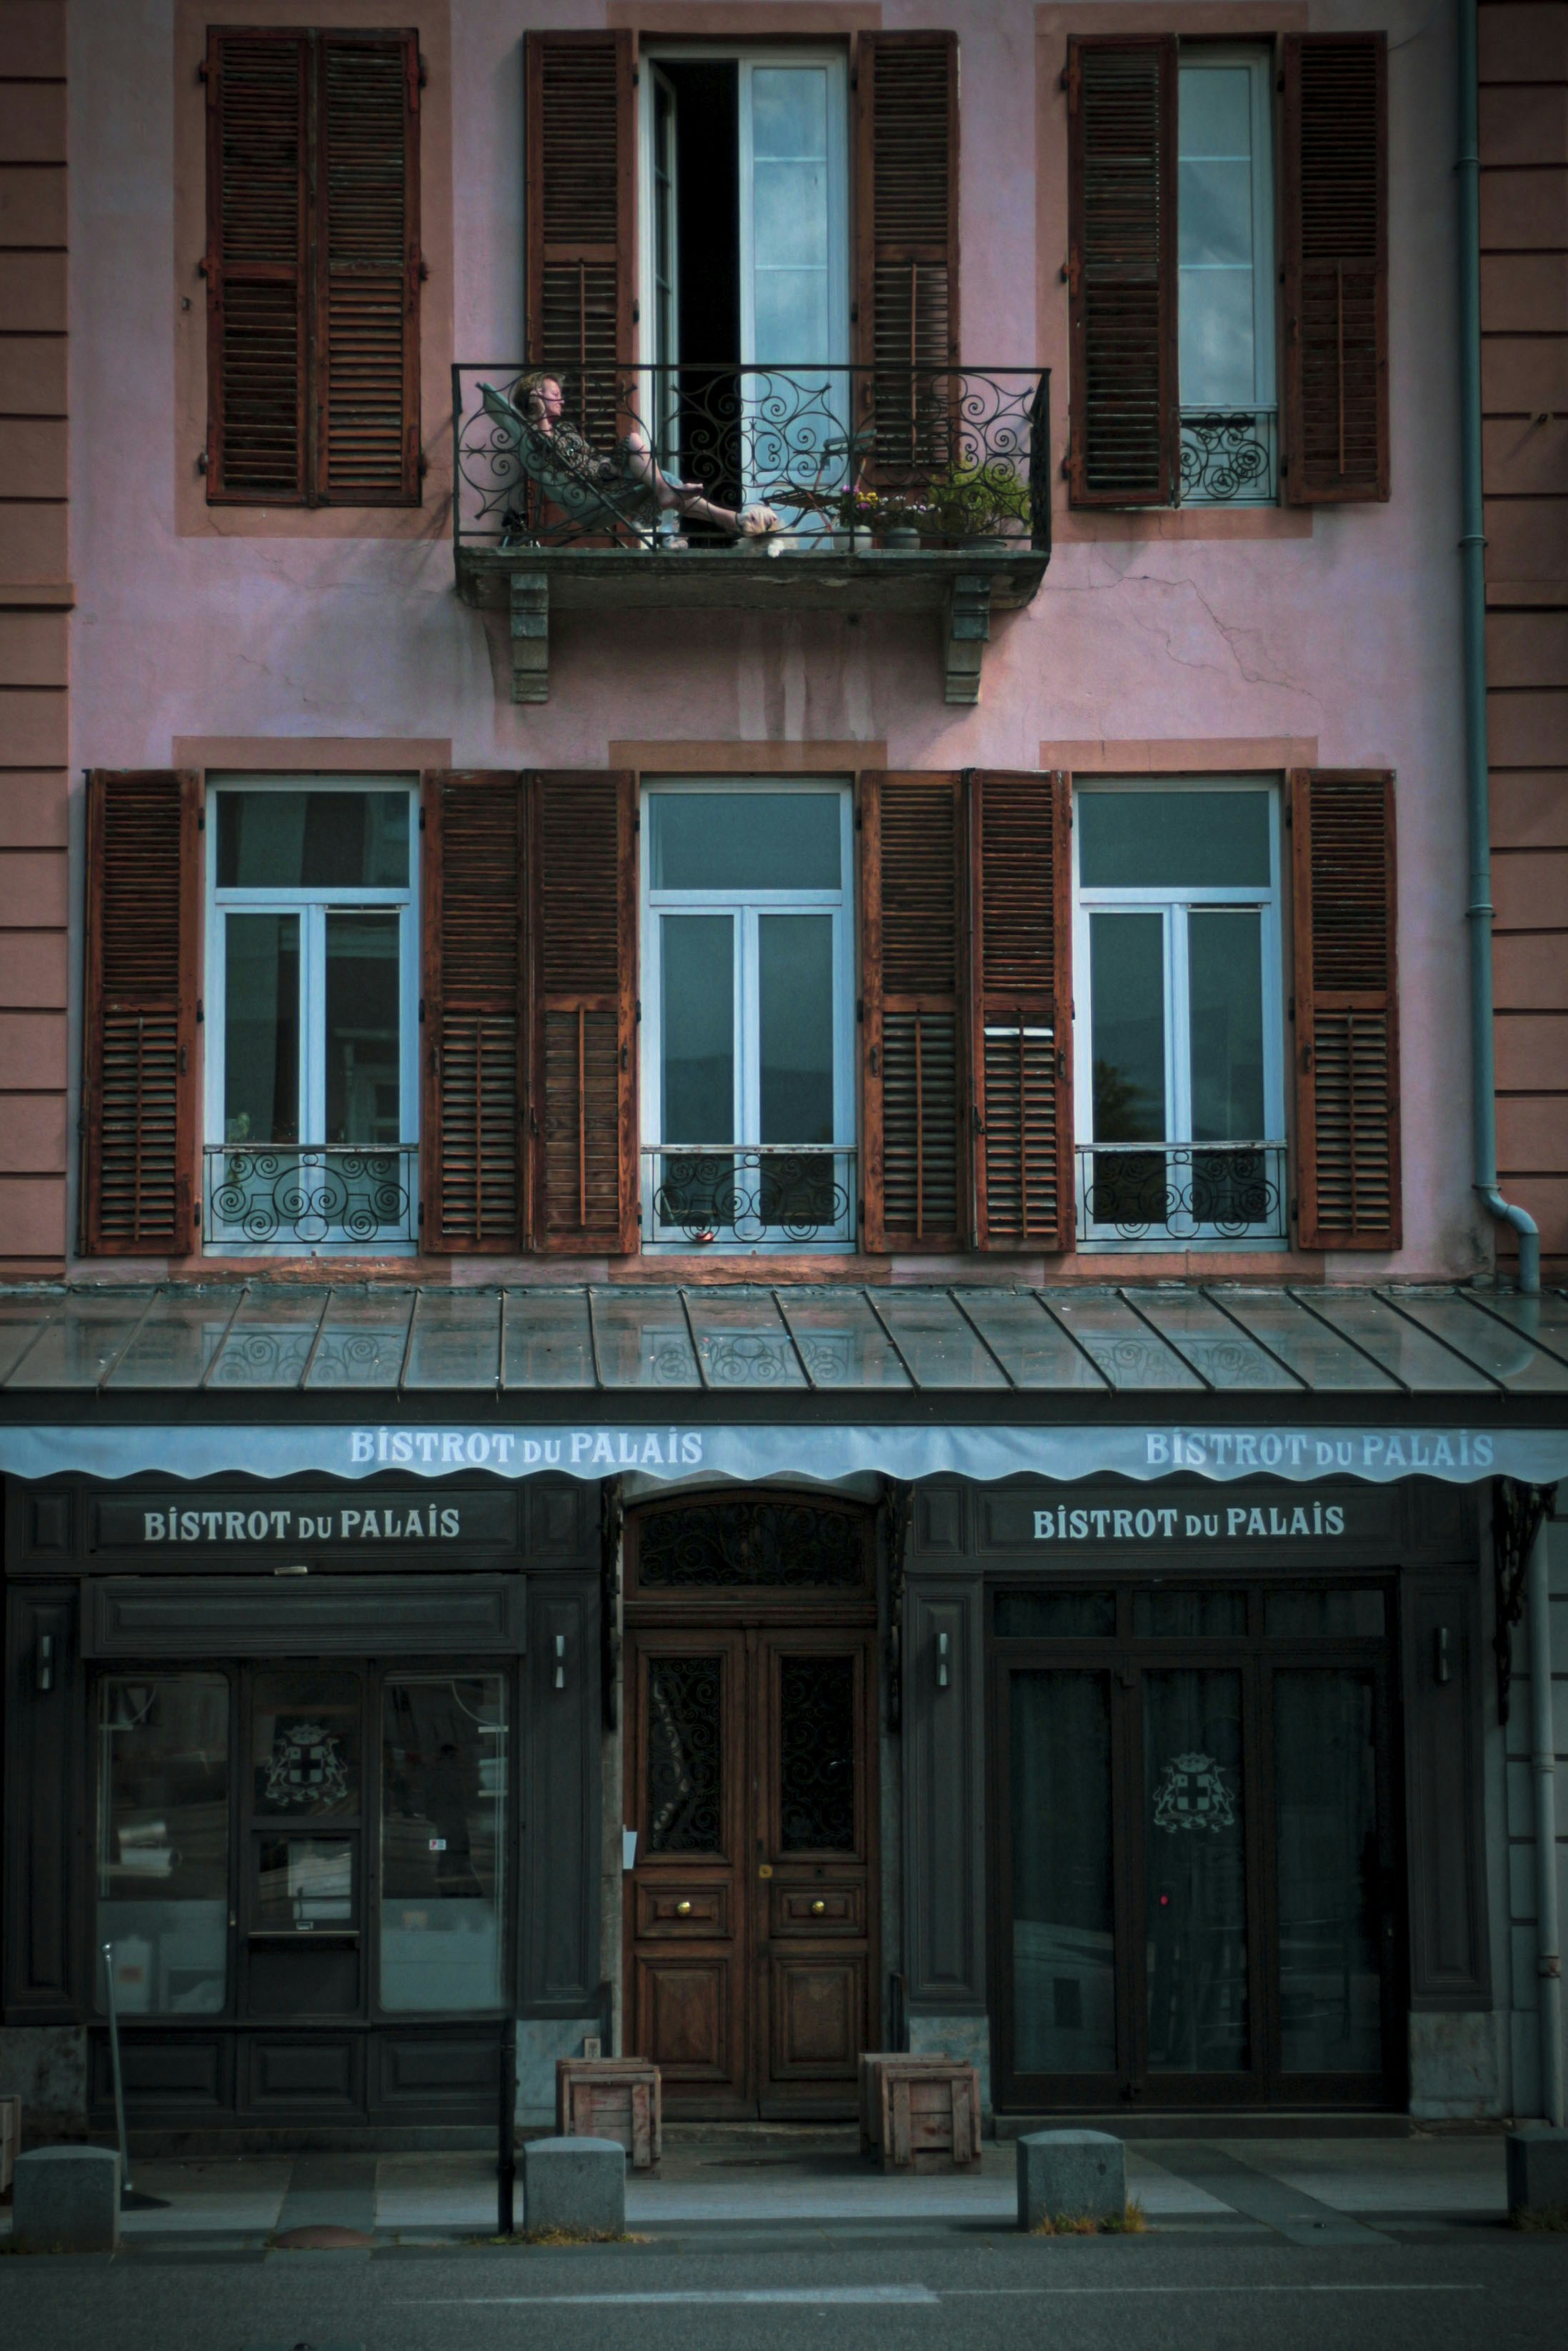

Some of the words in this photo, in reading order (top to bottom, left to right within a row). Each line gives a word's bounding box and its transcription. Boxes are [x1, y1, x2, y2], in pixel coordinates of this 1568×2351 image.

[524, 1439, 561, 1463] DU
[1317, 1442, 1353, 1466] DU
[298, 1517, 332, 1539] DU
[1185, 1514, 1218, 1537] DU
